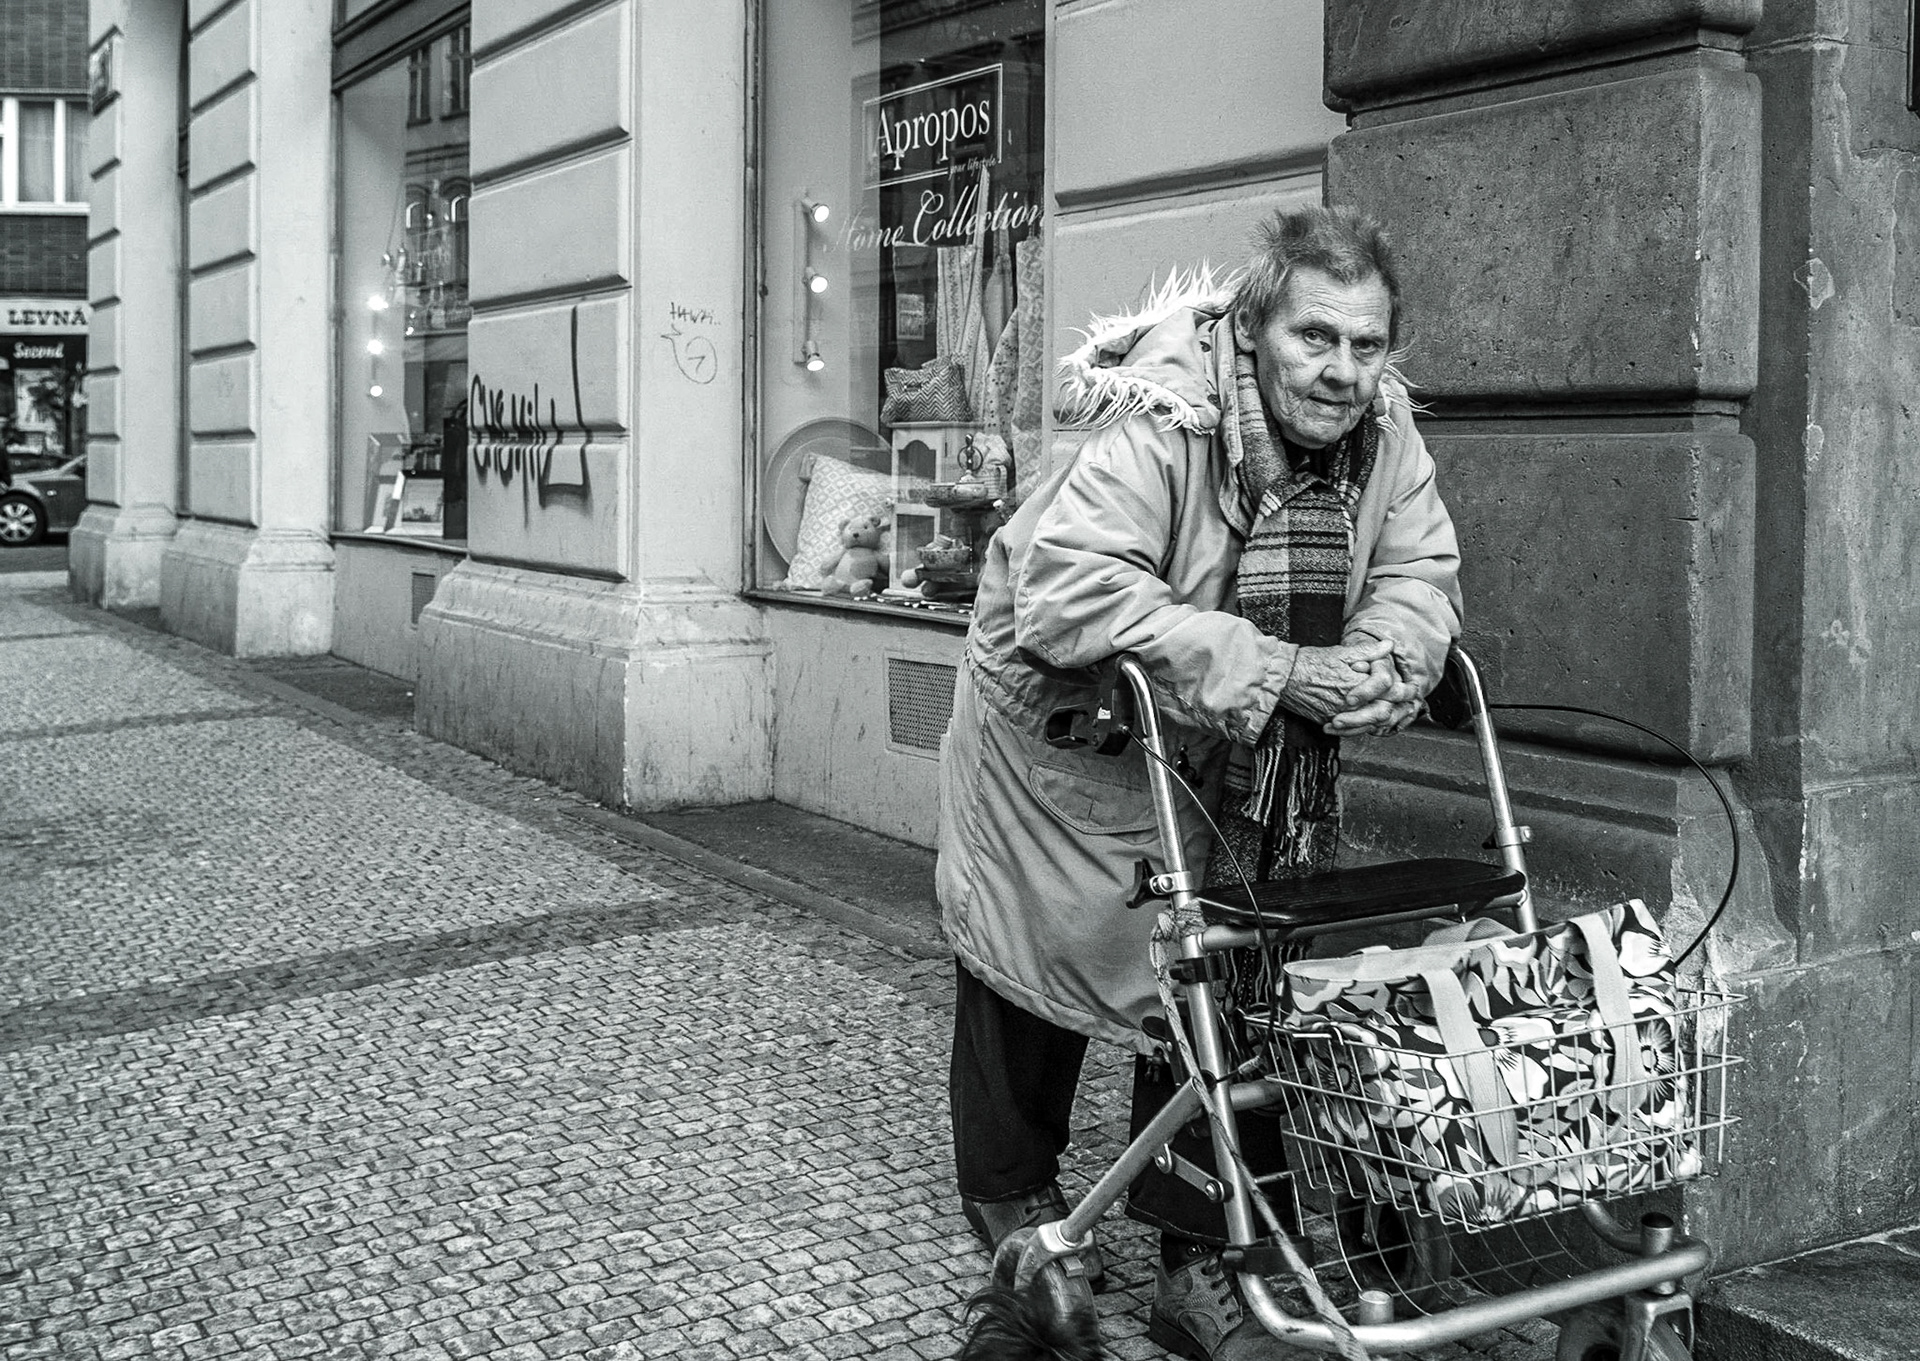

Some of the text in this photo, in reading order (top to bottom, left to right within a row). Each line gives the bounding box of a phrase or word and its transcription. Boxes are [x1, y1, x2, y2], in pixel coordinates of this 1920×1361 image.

[872, 99, 990, 171] Apropos
[912, 184, 1045, 246] Collection
[8, 306, 88, 326] LEVNÁ
[13, 342, 64, 359] Second
